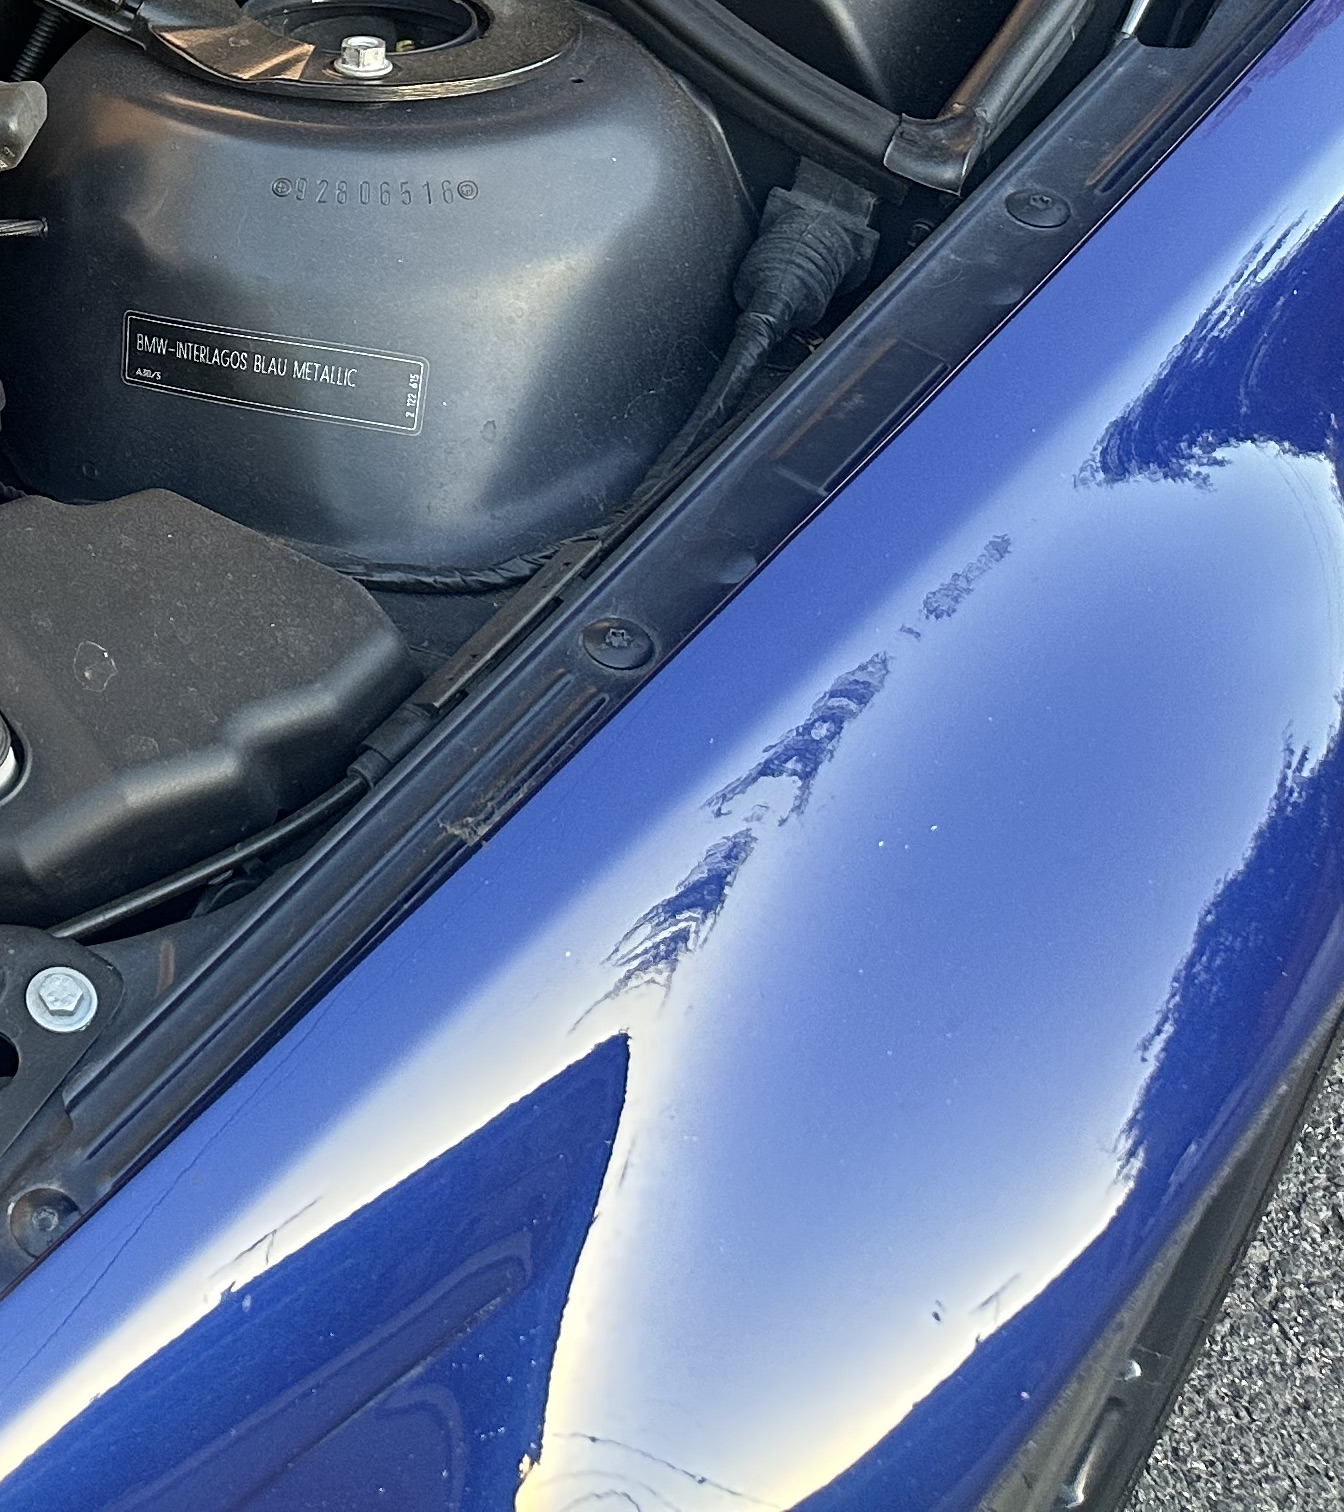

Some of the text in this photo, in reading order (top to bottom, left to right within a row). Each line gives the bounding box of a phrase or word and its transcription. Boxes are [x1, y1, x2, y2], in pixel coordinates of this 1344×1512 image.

[295, 177, 454, 206] 92806516
[136, 333, 358, 388] BMW-INTERLAGOS BLAU METALLIC
